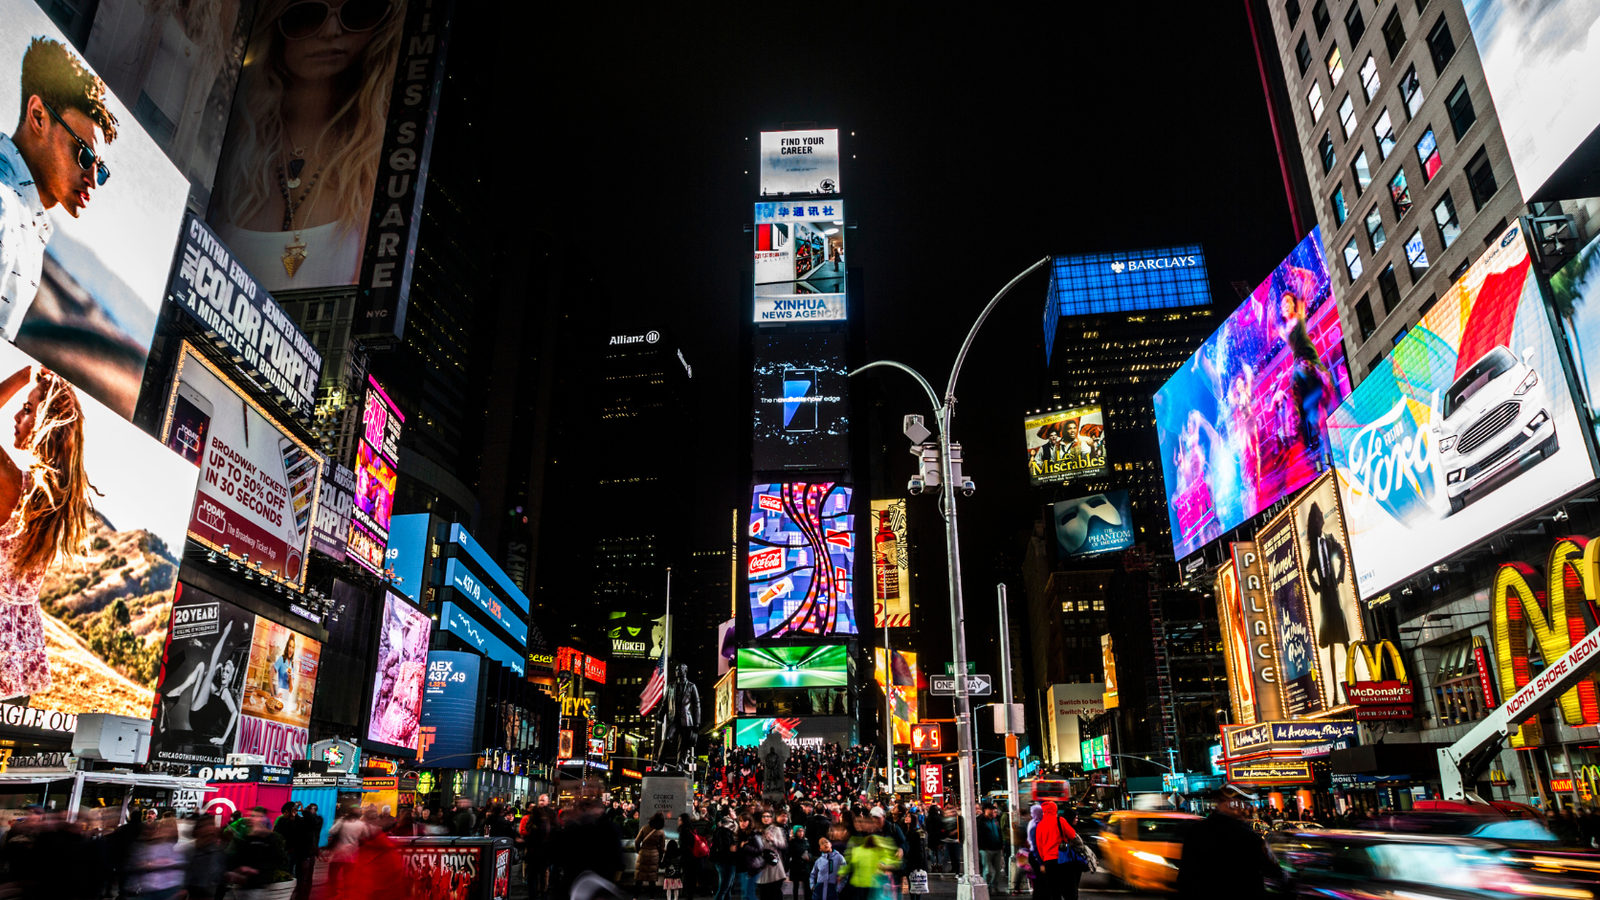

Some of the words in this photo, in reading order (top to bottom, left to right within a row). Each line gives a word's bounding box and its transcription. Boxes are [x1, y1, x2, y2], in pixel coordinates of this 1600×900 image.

[780, 138, 800, 146] FIND
[802, 137, 825, 145] YOUR
[780, 146, 813, 155] CAREER
[371, 121, 416, 288] SQUARE
[1128, 256, 1196, 271] BARCLAYS
[189, 219, 230, 272] CYNTHIA
[228, 259, 257, 300] ERIVO
[261, 297, 295, 343] JENNIFER
[293, 330, 322, 373] HUDSON
[773, 299, 827, 310] XINHUA
[366, 309, 388, 318] NYC
[762, 311, 792, 319] NEWS
[180, 243, 201, 288] THE
[194, 255, 262, 348] COLOR
[258, 318, 319, 405] PURPLE
[197, 302, 245, 354] MIRACLE
[244, 344, 259, 368] ON
[609, 335, 644, 345] Allianz
[1383, 420, 1404, 447] FUSION
[1056, 450, 1075, 462] Les
[211, 436, 258, 475] BROADWAY
[259, 470, 287, 497] TICKETS
[1031, 453, 1106, 476] Misérables
[209, 453, 225, 470] UP
[228, 463, 242, 483] TO
[242, 476, 265, 499] 50%
[265, 491, 286, 511] OFF
[205, 467, 219, 487] IN
[219, 477, 235, 497] 30
[235, 487, 283, 527] SECONDS
[202, 499, 226, 519] TODAY
[205, 512, 219, 528] TIX
[227, 522, 236, 536] The
[235, 528, 256, 548] Broadway
[255, 538, 269, 553] Ticket
[267, 544, 277, 559] App
[459, 531, 467, 545] AEX
[1088, 530, 1131, 542] PHANTOM
[750, 553, 781, 570] Coca-Cola
[175, 609, 188, 623] 20
[189, 607, 217, 621] YEARS
[1244, 552, 1275, 683] PALACE
[429, 661, 453, 672] AEX
[428, 671, 466, 683] 437.49
[1506, 686, 1536, 716] NORTH
[1536, 660, 1568, 692] SHORE
[1568, 637, 1598, 667] NEON
[935, 681, 954, 689] ONE
[1350, 687, 1411, 697] McDonald's
[238, 715, 308, 767] WAITRESS
[214, 767, 249, 780] NYC
[925, 767, 940, 793] tkts
